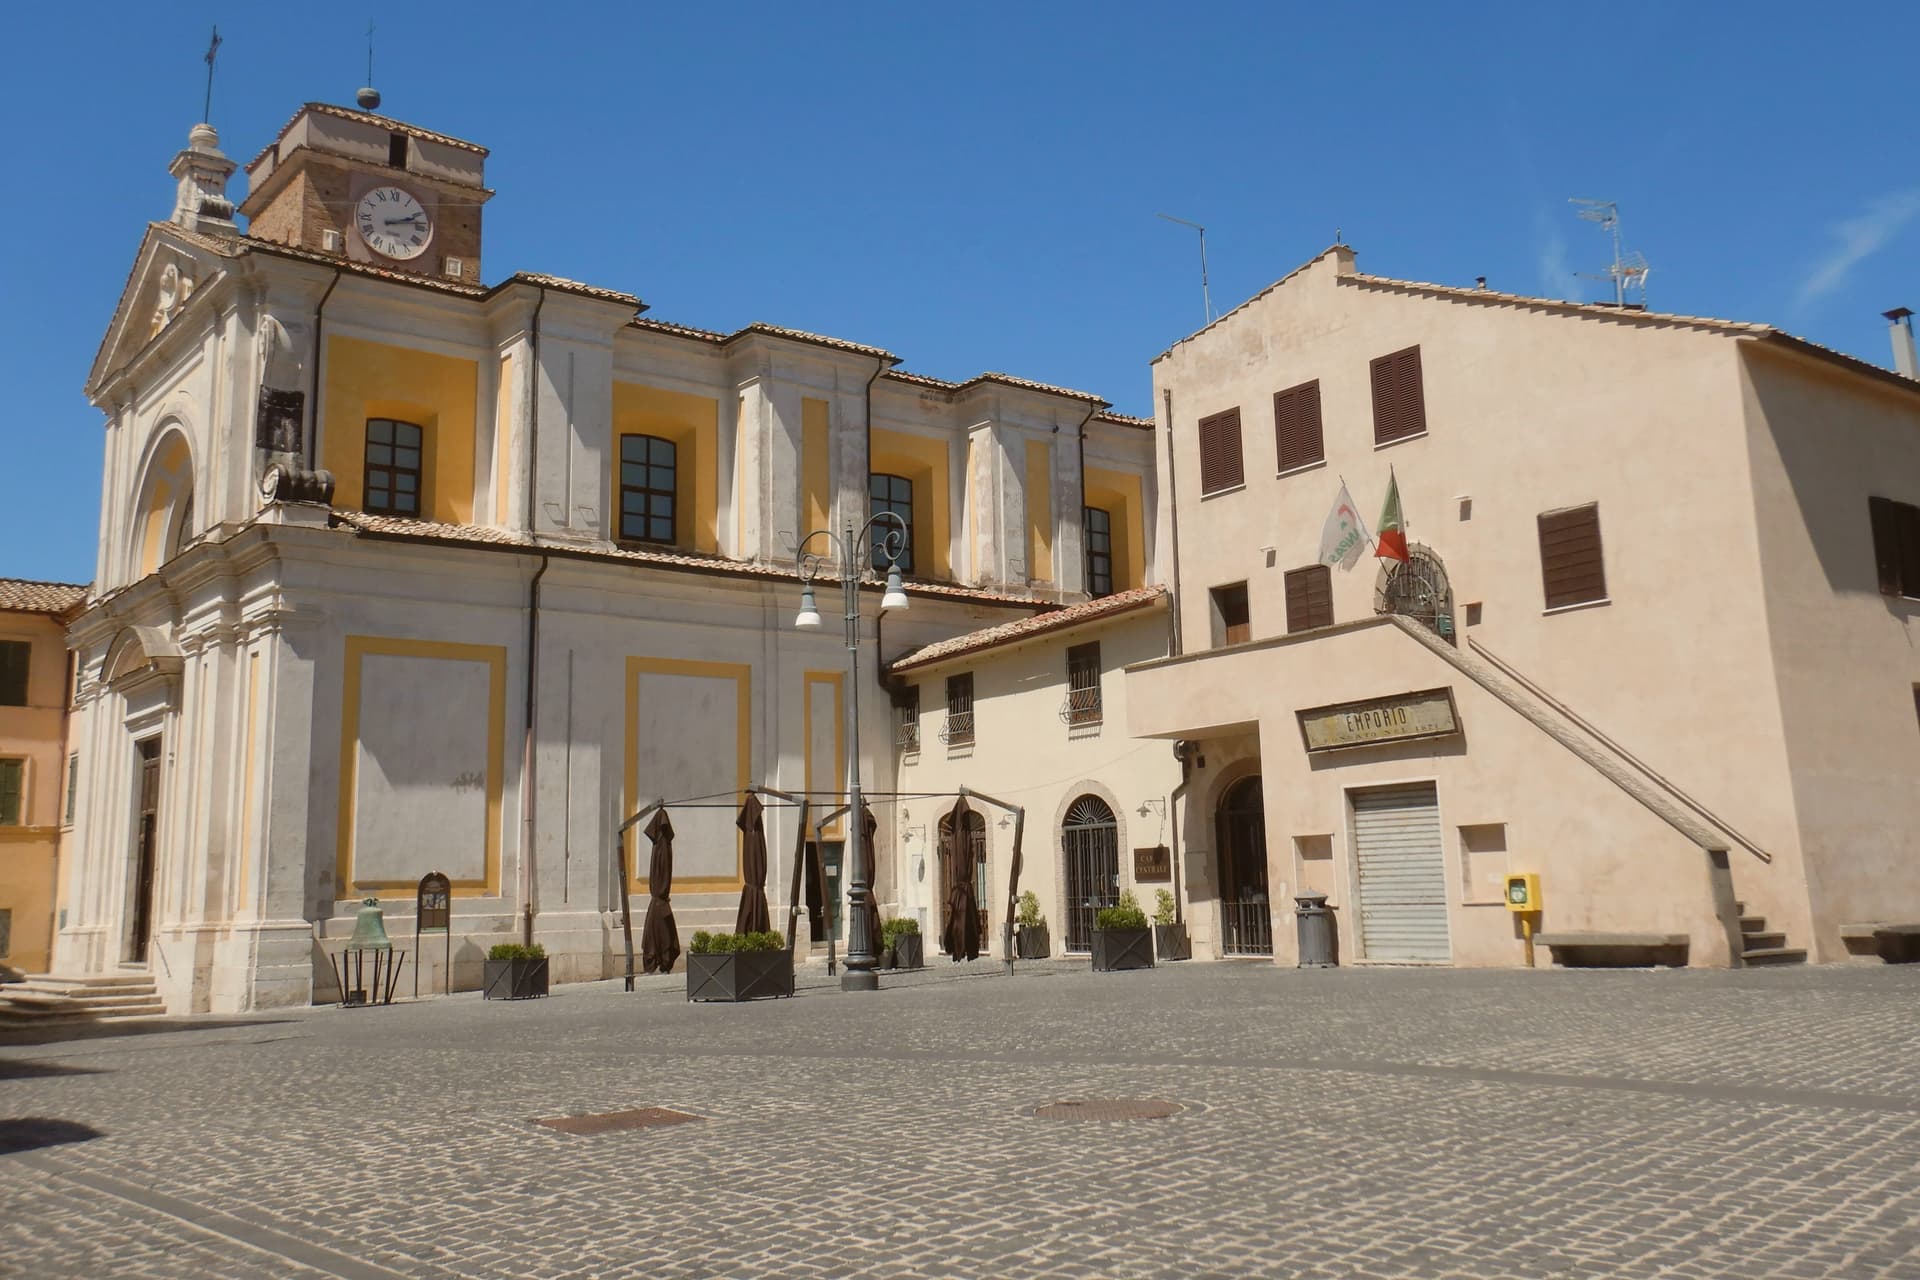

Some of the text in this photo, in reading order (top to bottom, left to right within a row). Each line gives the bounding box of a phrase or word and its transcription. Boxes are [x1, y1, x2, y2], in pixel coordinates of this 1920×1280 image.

[376, 190, 386, 202] XI
[390, 190, 400, 202] XII
[364, 198, 376, 208] X
[1346, 707, 1407, 732] EMPORIO
